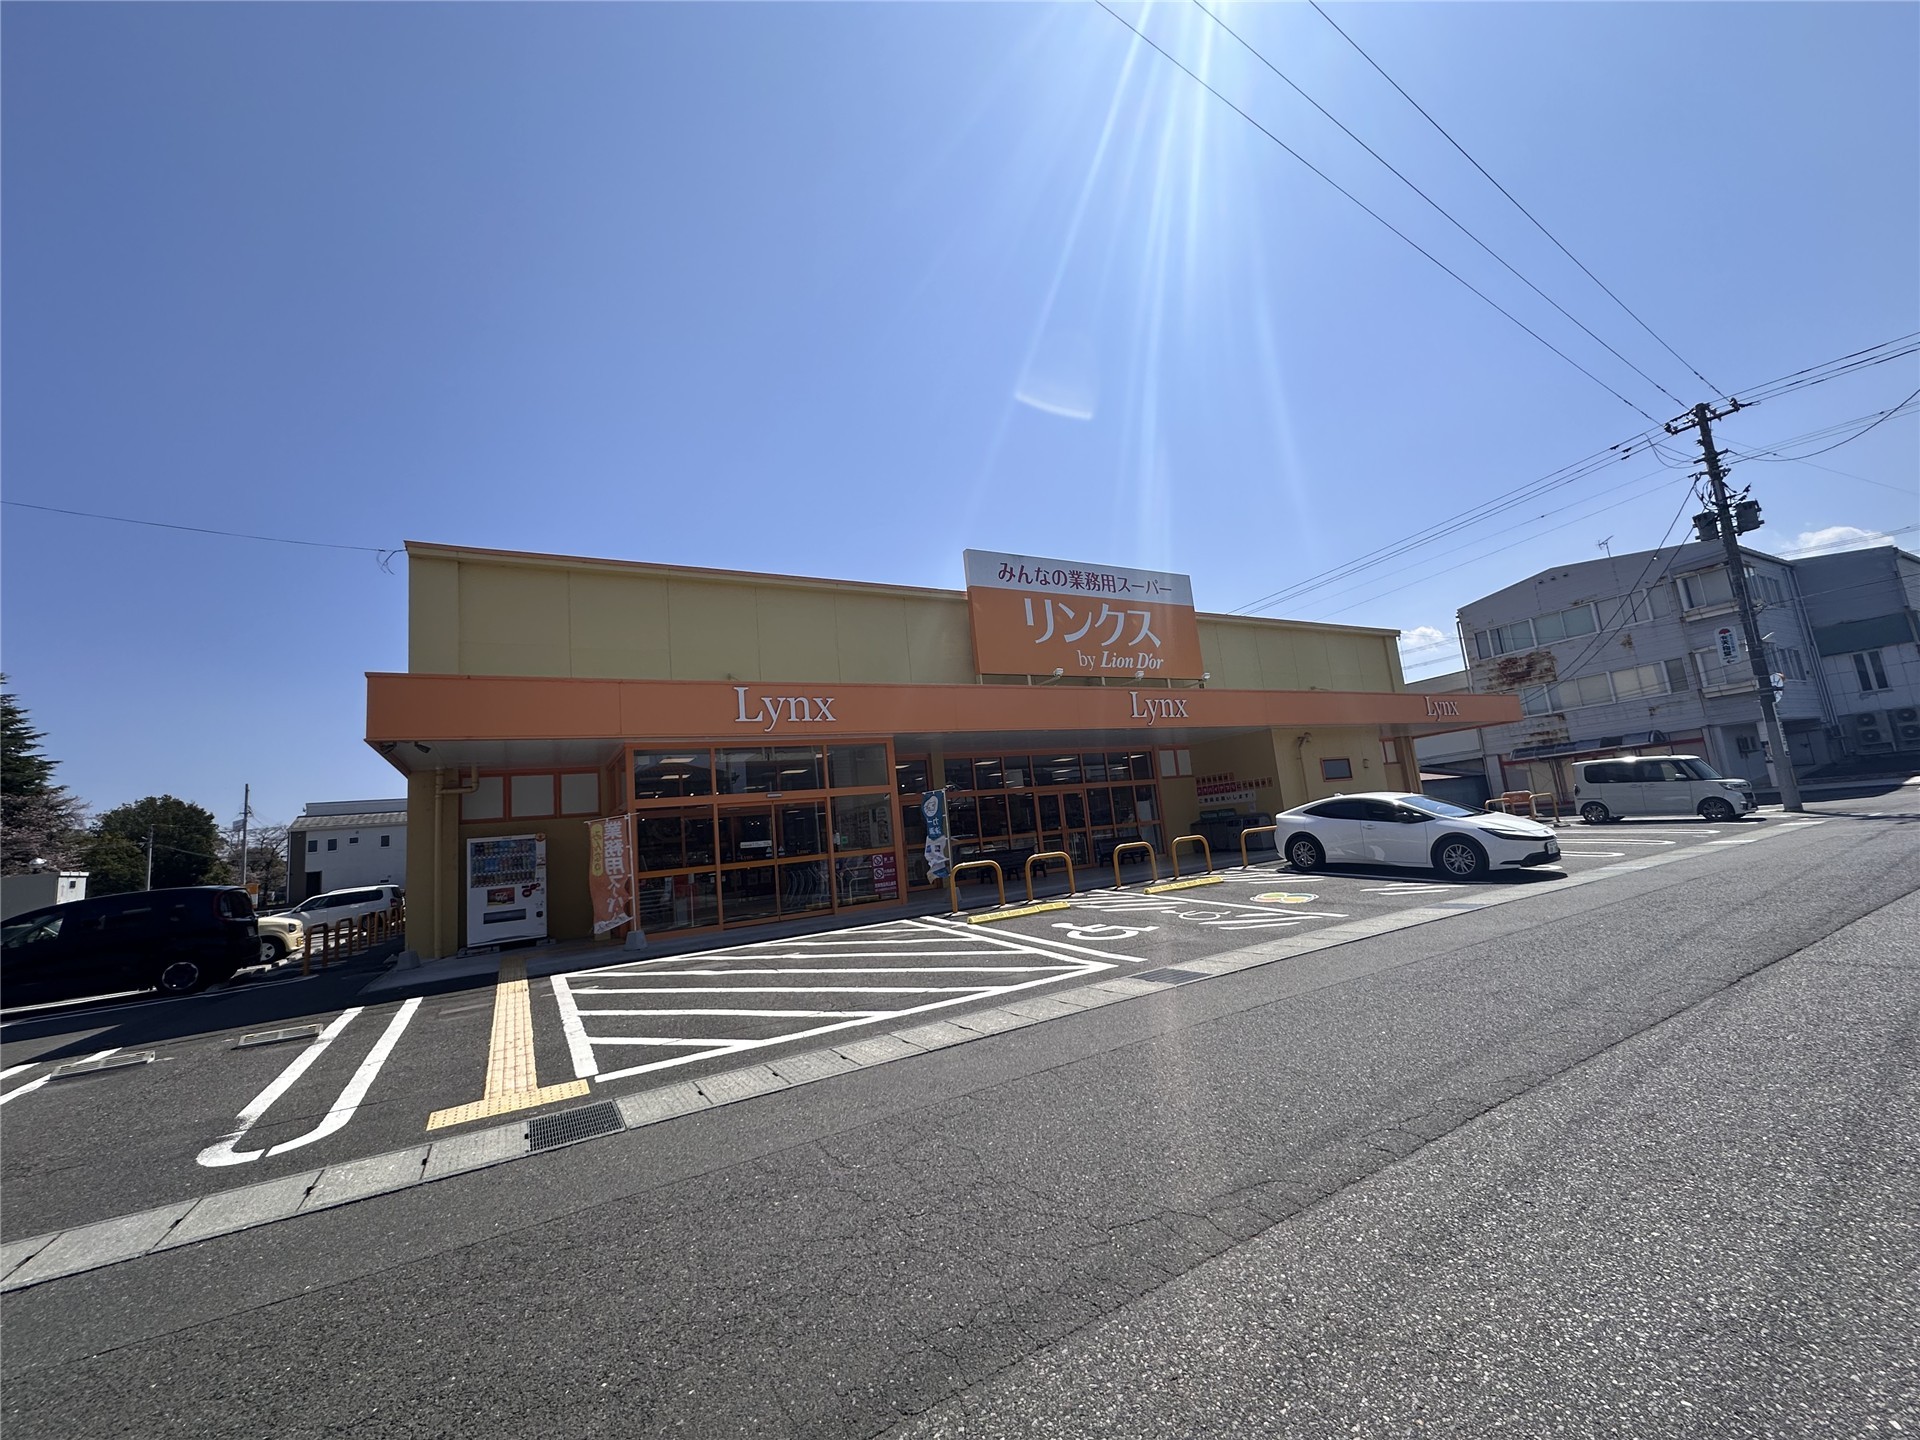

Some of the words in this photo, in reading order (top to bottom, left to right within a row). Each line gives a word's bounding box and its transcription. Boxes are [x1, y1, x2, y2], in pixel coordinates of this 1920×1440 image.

[998, 562, 1173, 595] みんなの業務用スーパー
[1024, 597, 1162, 649] リンクス
[1076, 649, 1096, 671] by
[1100, 651, 1134, 669] Lion
[1136, 651, 1165, 670] D'or
[733, 686, 836, 732] Lynx
[1129, 691, 1189, 726] Lynx
[1424, 695, 1460, 722] Lynx
